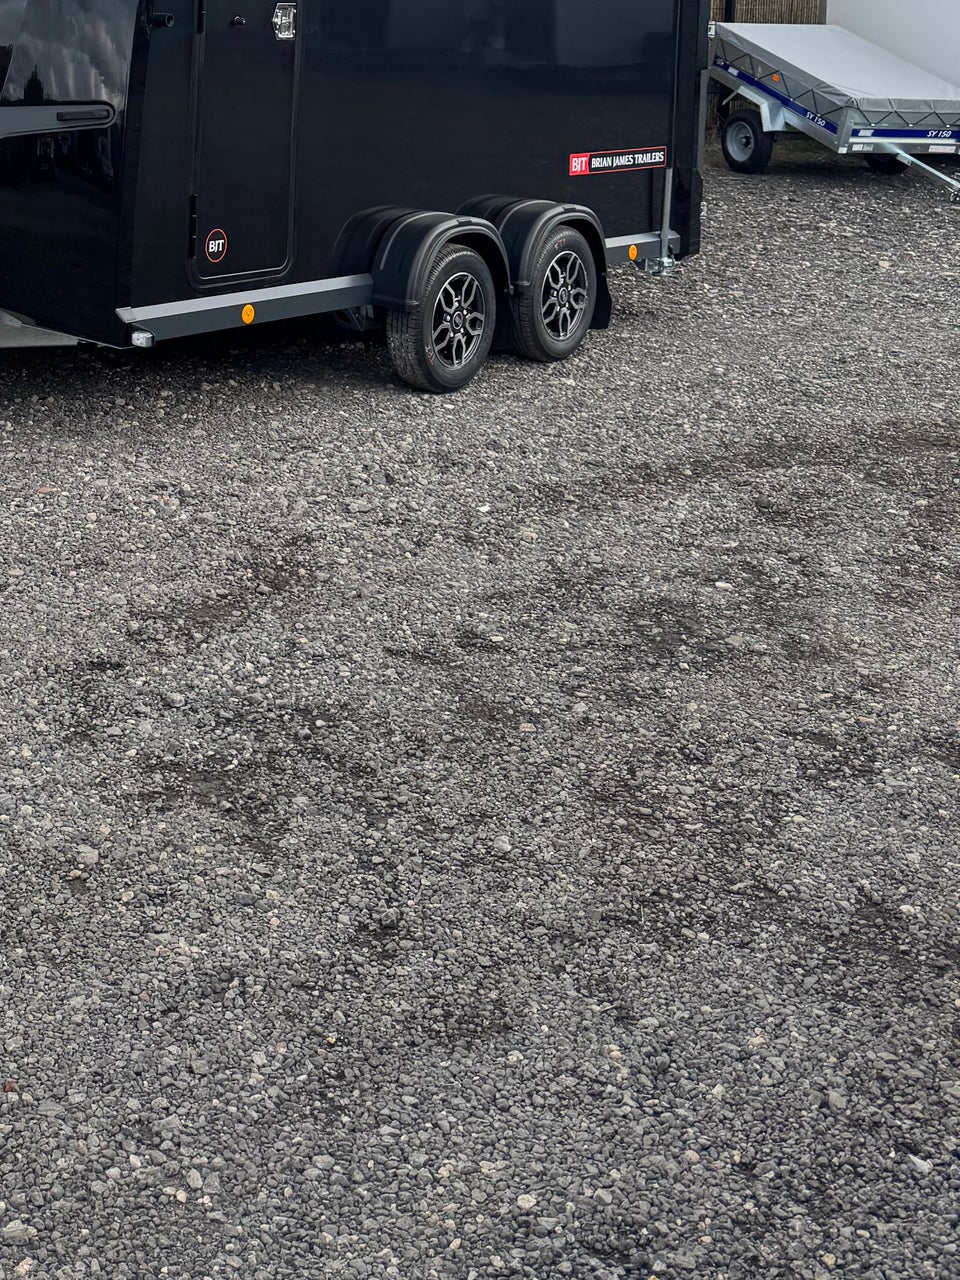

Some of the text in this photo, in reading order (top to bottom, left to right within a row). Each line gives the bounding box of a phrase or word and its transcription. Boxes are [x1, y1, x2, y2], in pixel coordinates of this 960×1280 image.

[814, 116, 826, 127] 150
[591, 157, 613, 169] BRIAN
[613, 154, 634, 168] JAMES
[634, 152, 665, 165] TRAILERS
